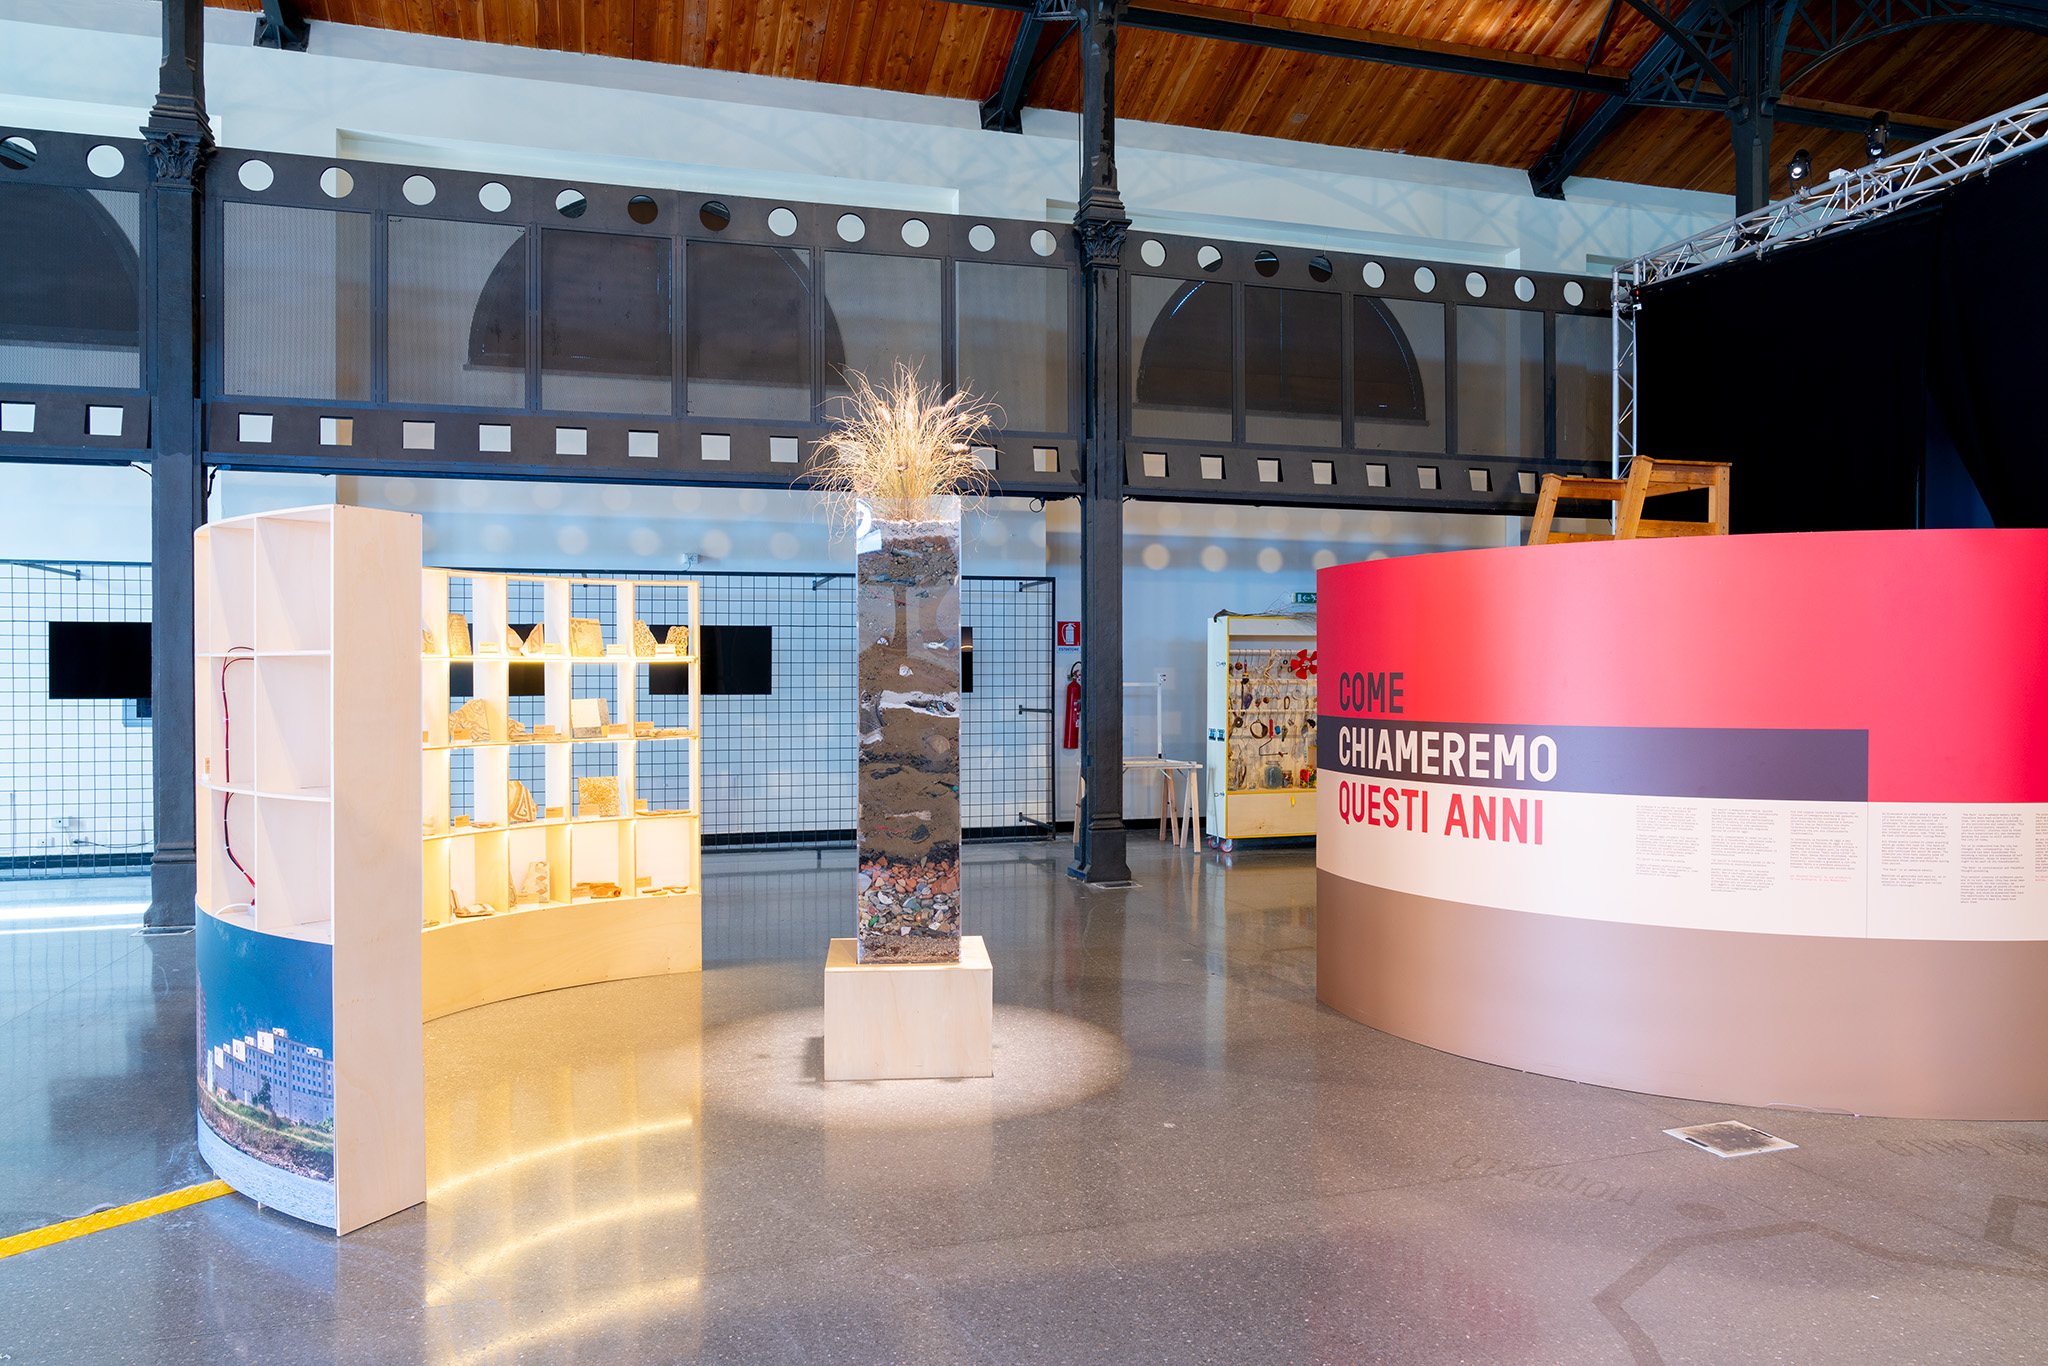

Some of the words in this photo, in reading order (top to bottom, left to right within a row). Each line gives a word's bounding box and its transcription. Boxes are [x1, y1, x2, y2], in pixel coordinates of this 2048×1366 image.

[1339, 671, 1404, 714] COME
[1338, 725, 1558, 783] CHIAMEREMO
[1338, 780, 1429, 834] QUESTI
[1444, 793, 1543, 846] ANNI
